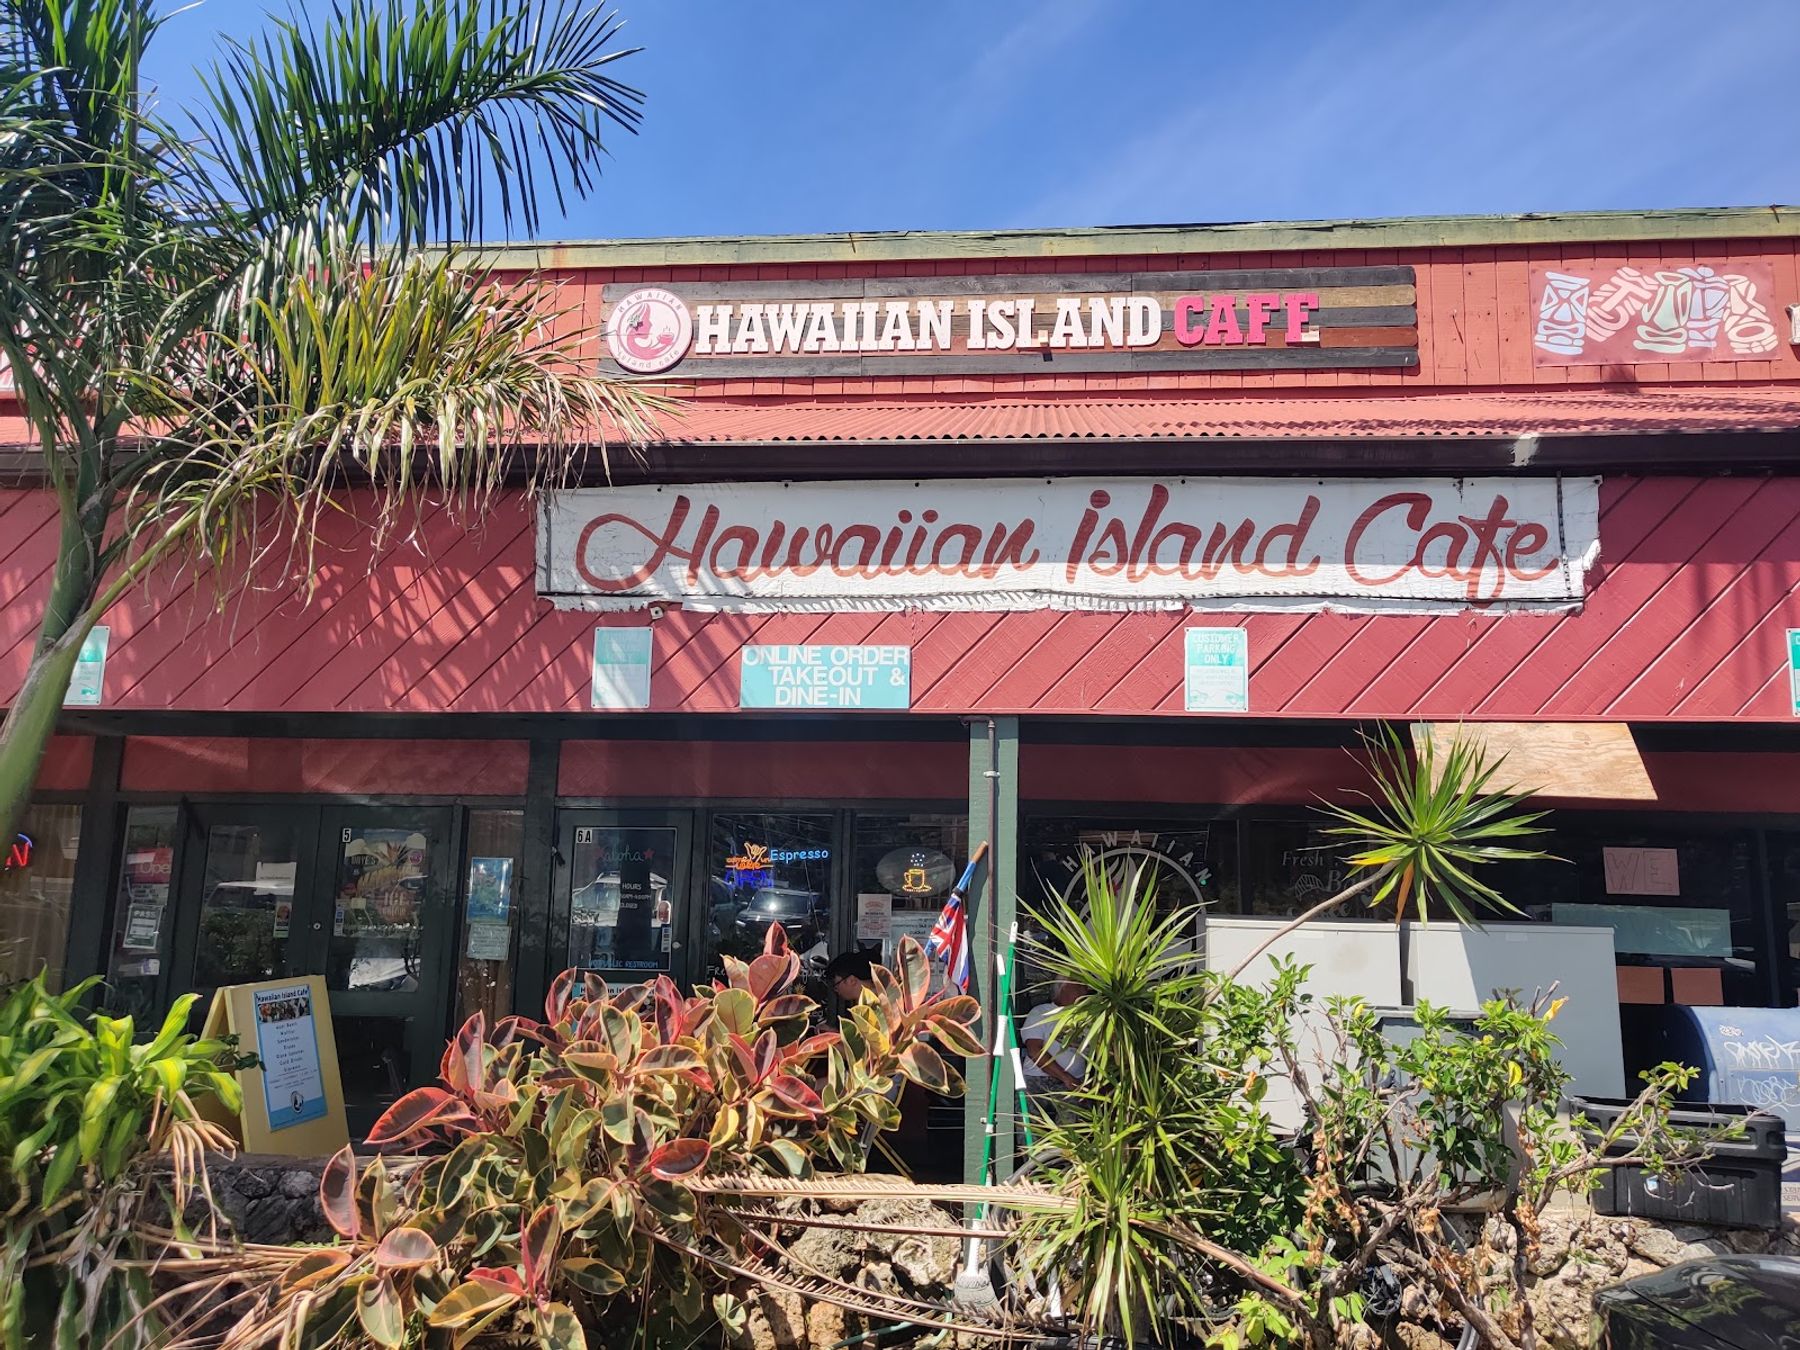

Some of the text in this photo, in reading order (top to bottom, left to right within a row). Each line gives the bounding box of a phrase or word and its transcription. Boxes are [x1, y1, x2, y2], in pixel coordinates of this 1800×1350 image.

[696, 293, 1320, 353] HAWAIIAN ISLAND CAFE
[576, 495, 1040, 591] Hawaiian
[1344, 492, 1559, 609] Cafe
[743, 647, 909, 666] ONLINE ORDER
[1204, 654, 1229, 664] ONLY
[768, 666, 906, 686] TAKEOUT &
[775, 687, 861, 706] DINE-IN
[343, 829, 350, 841] 5
[771, 849, 829, 864] Espresso
[1062, 830, 1213, 881] HAWAIIAN
[1282, 850, 1324, 866] Fresh
[140, 862, 170, 876] Ope
